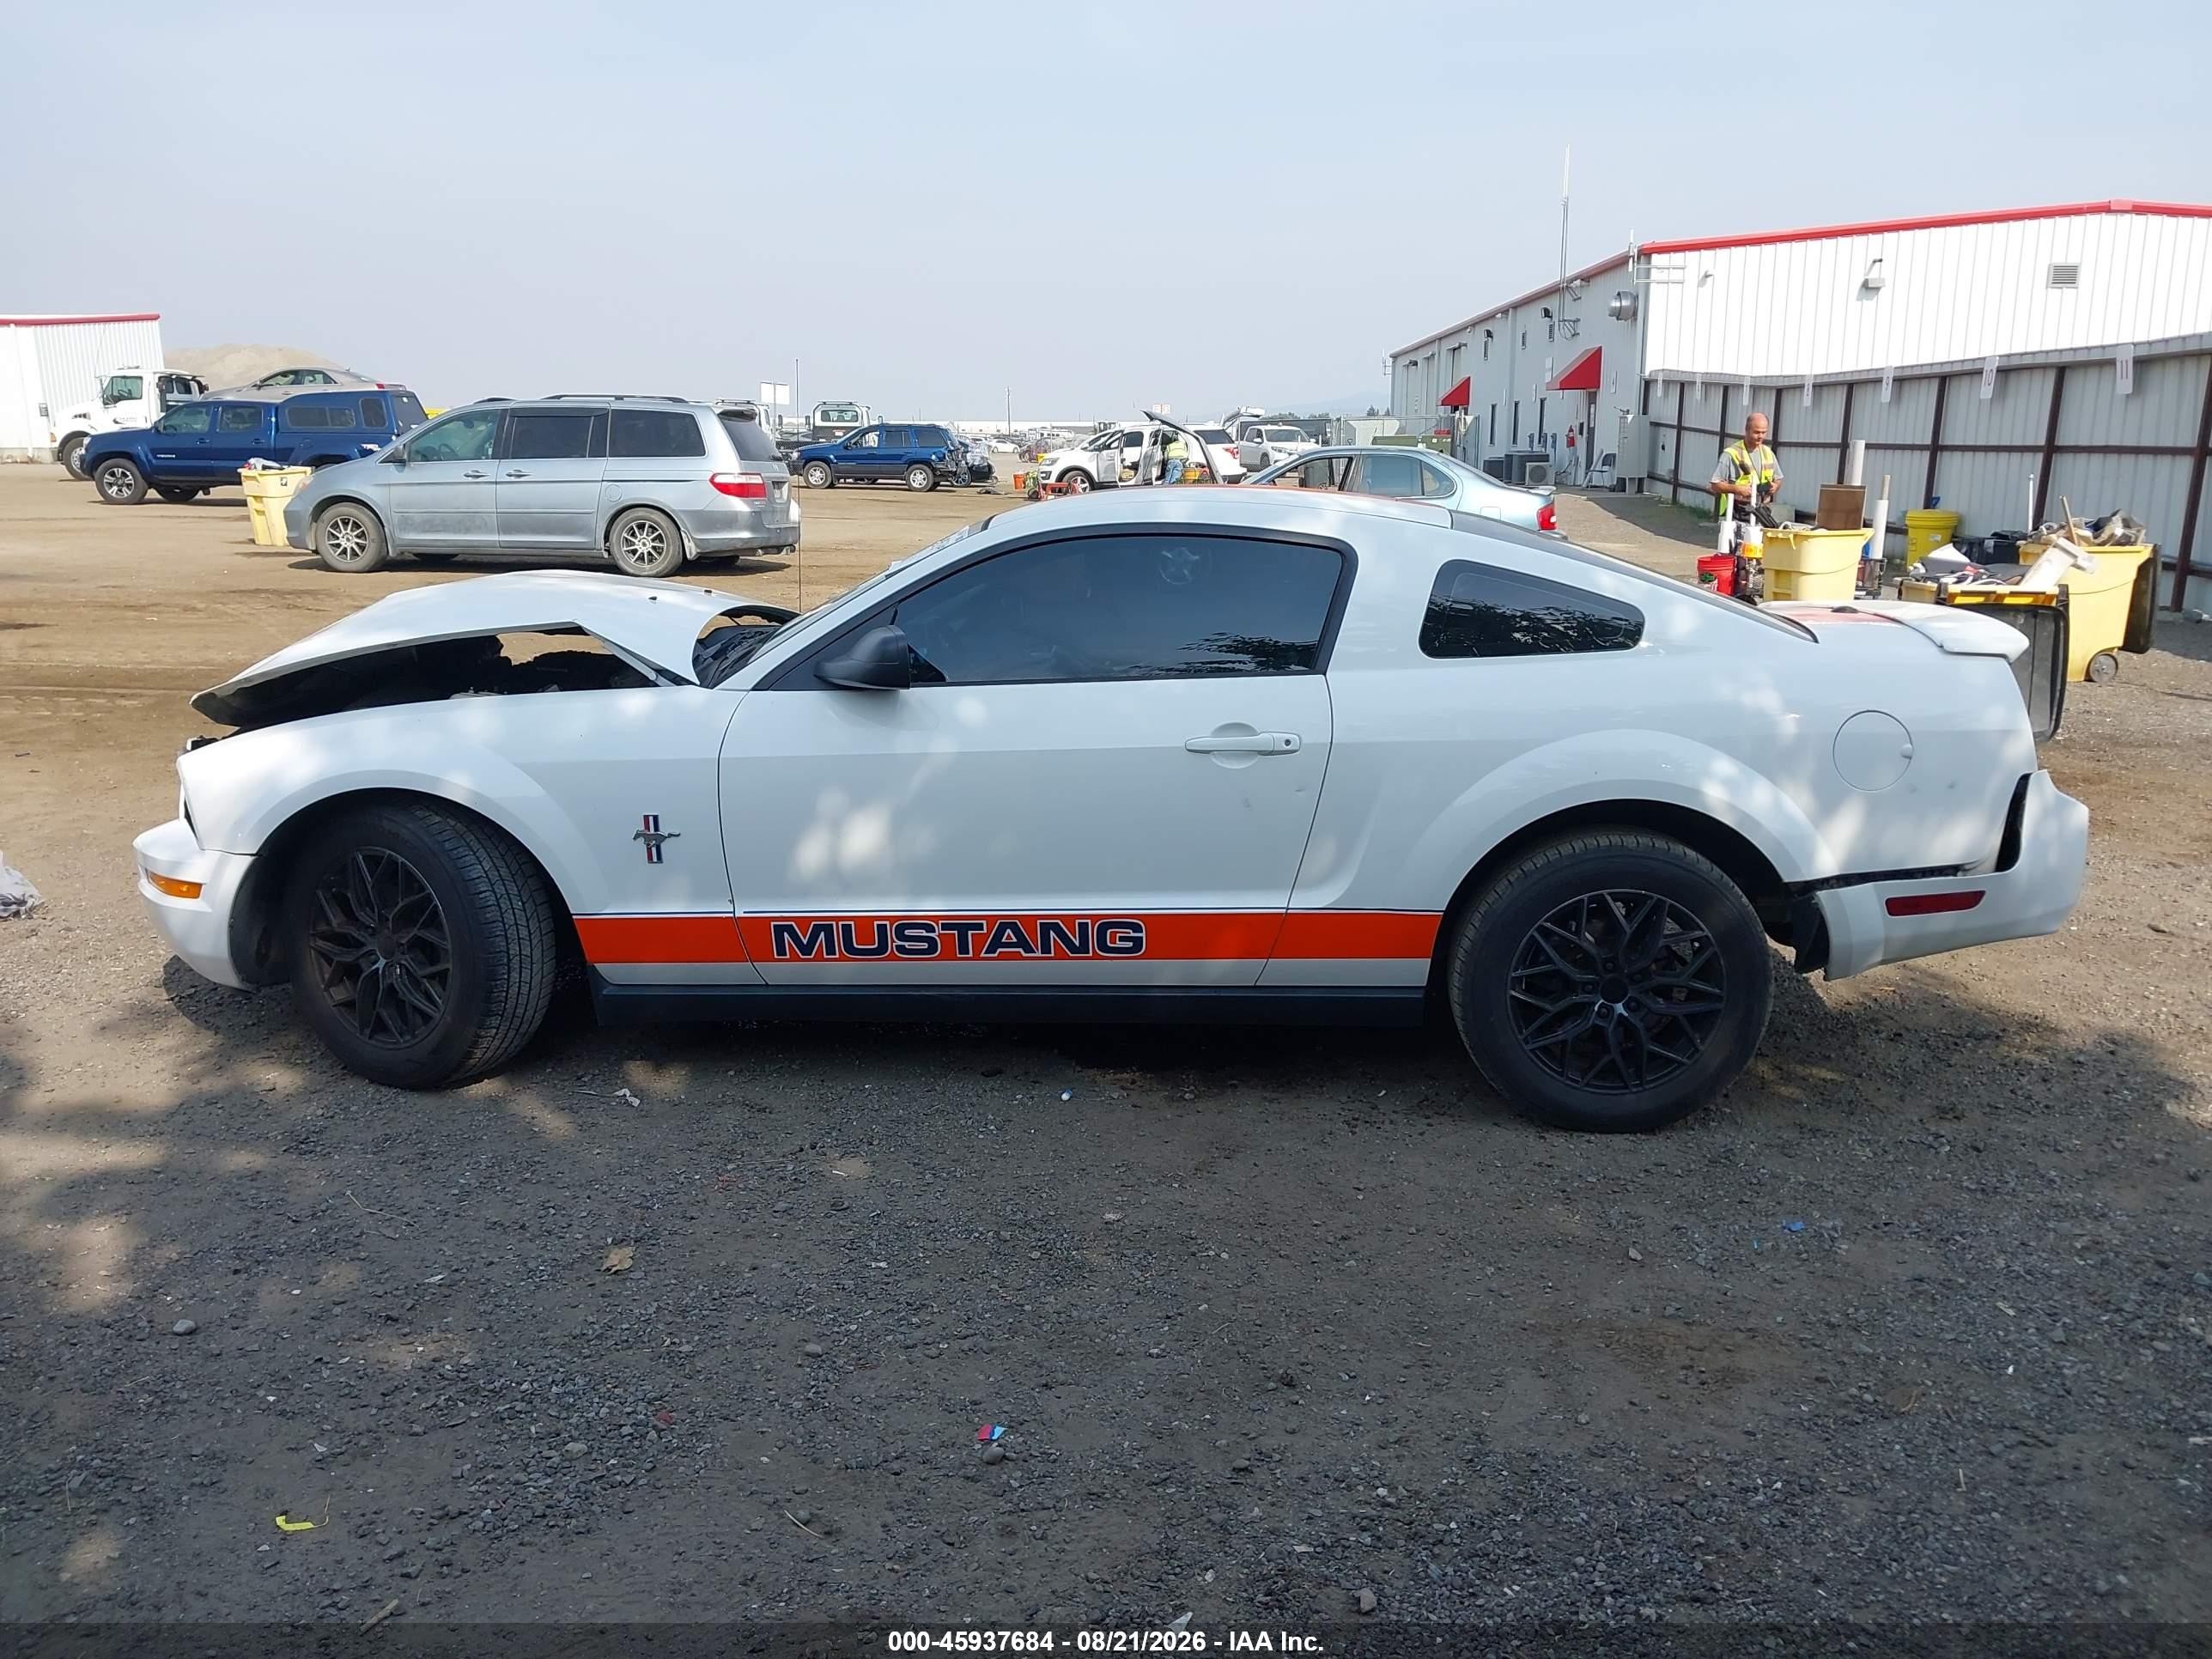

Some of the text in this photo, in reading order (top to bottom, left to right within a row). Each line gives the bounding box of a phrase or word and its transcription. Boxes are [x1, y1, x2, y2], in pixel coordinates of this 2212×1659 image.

[1983, 368, 1994, 386] 10
[2118, 358, 2130, 380] 11
[770, 918, 1147, 960] MUSTANG
